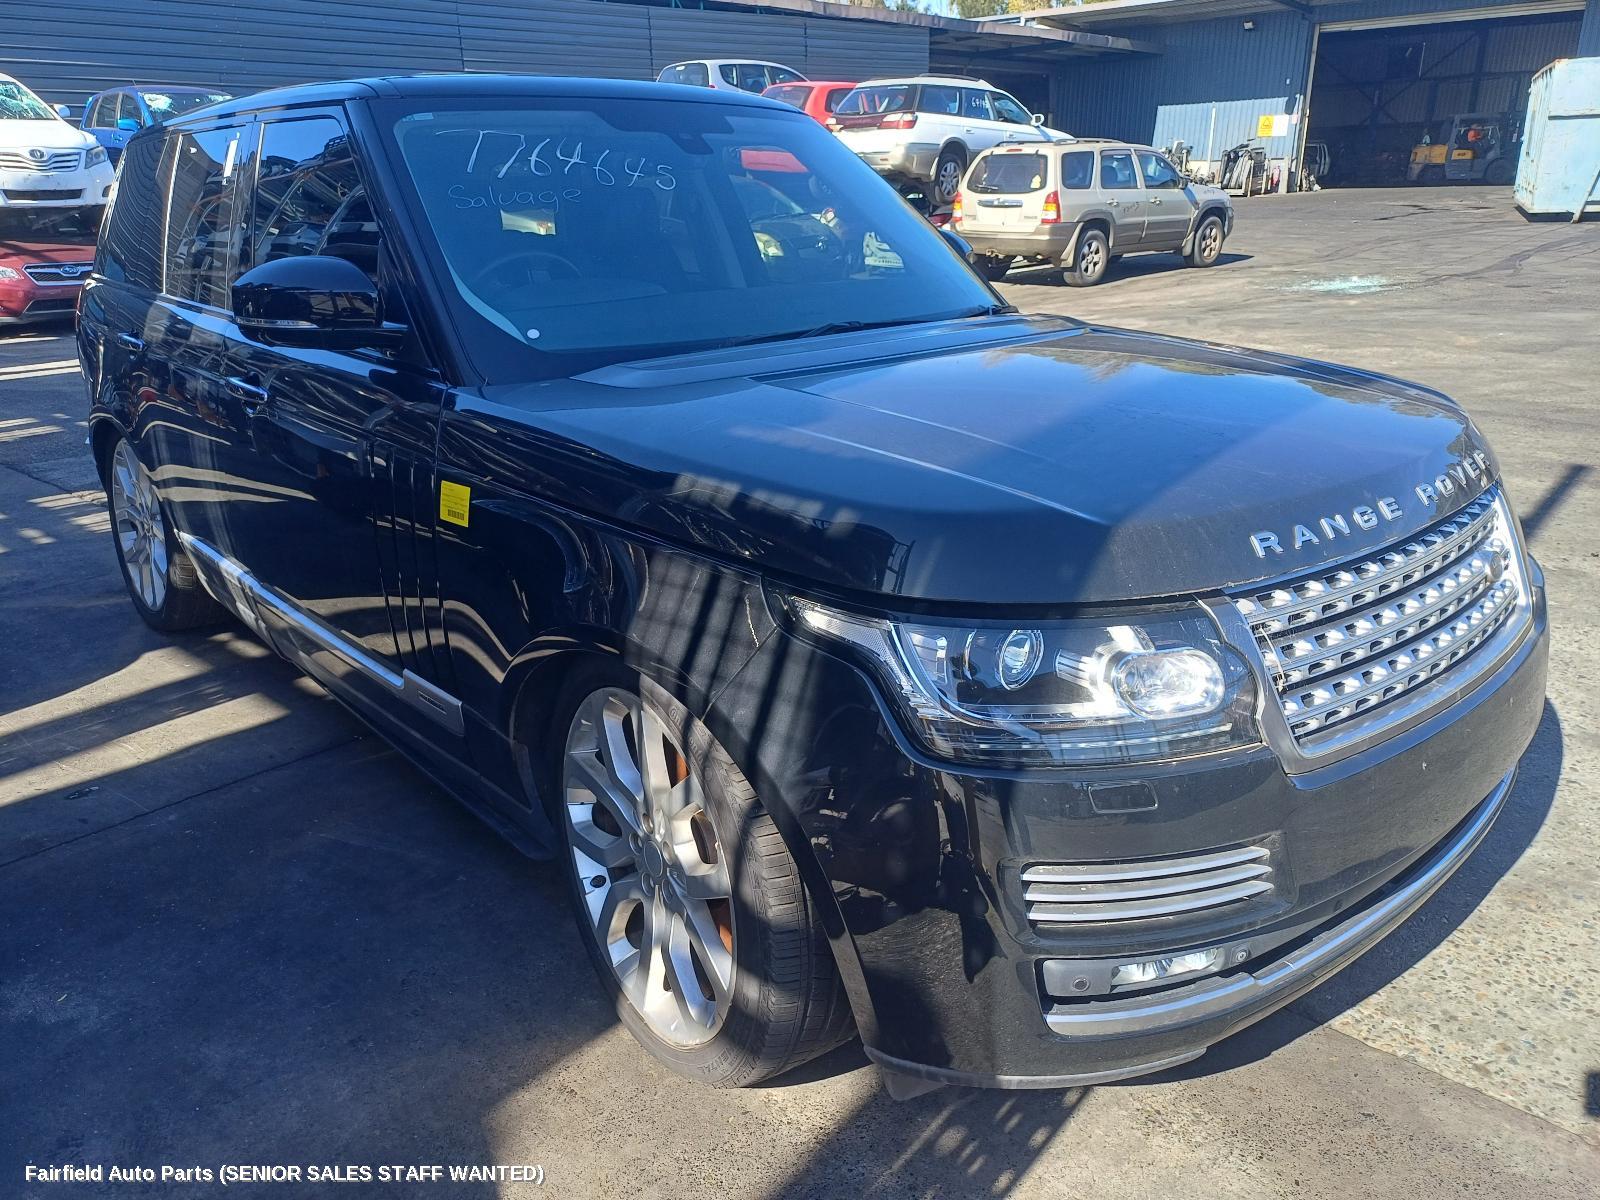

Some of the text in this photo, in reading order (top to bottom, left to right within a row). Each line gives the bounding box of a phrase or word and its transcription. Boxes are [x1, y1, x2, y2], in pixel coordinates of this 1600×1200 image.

[447, 184, 583, 213] Salvage
[1250, 449, 1491, 559] RANGE ROVER
